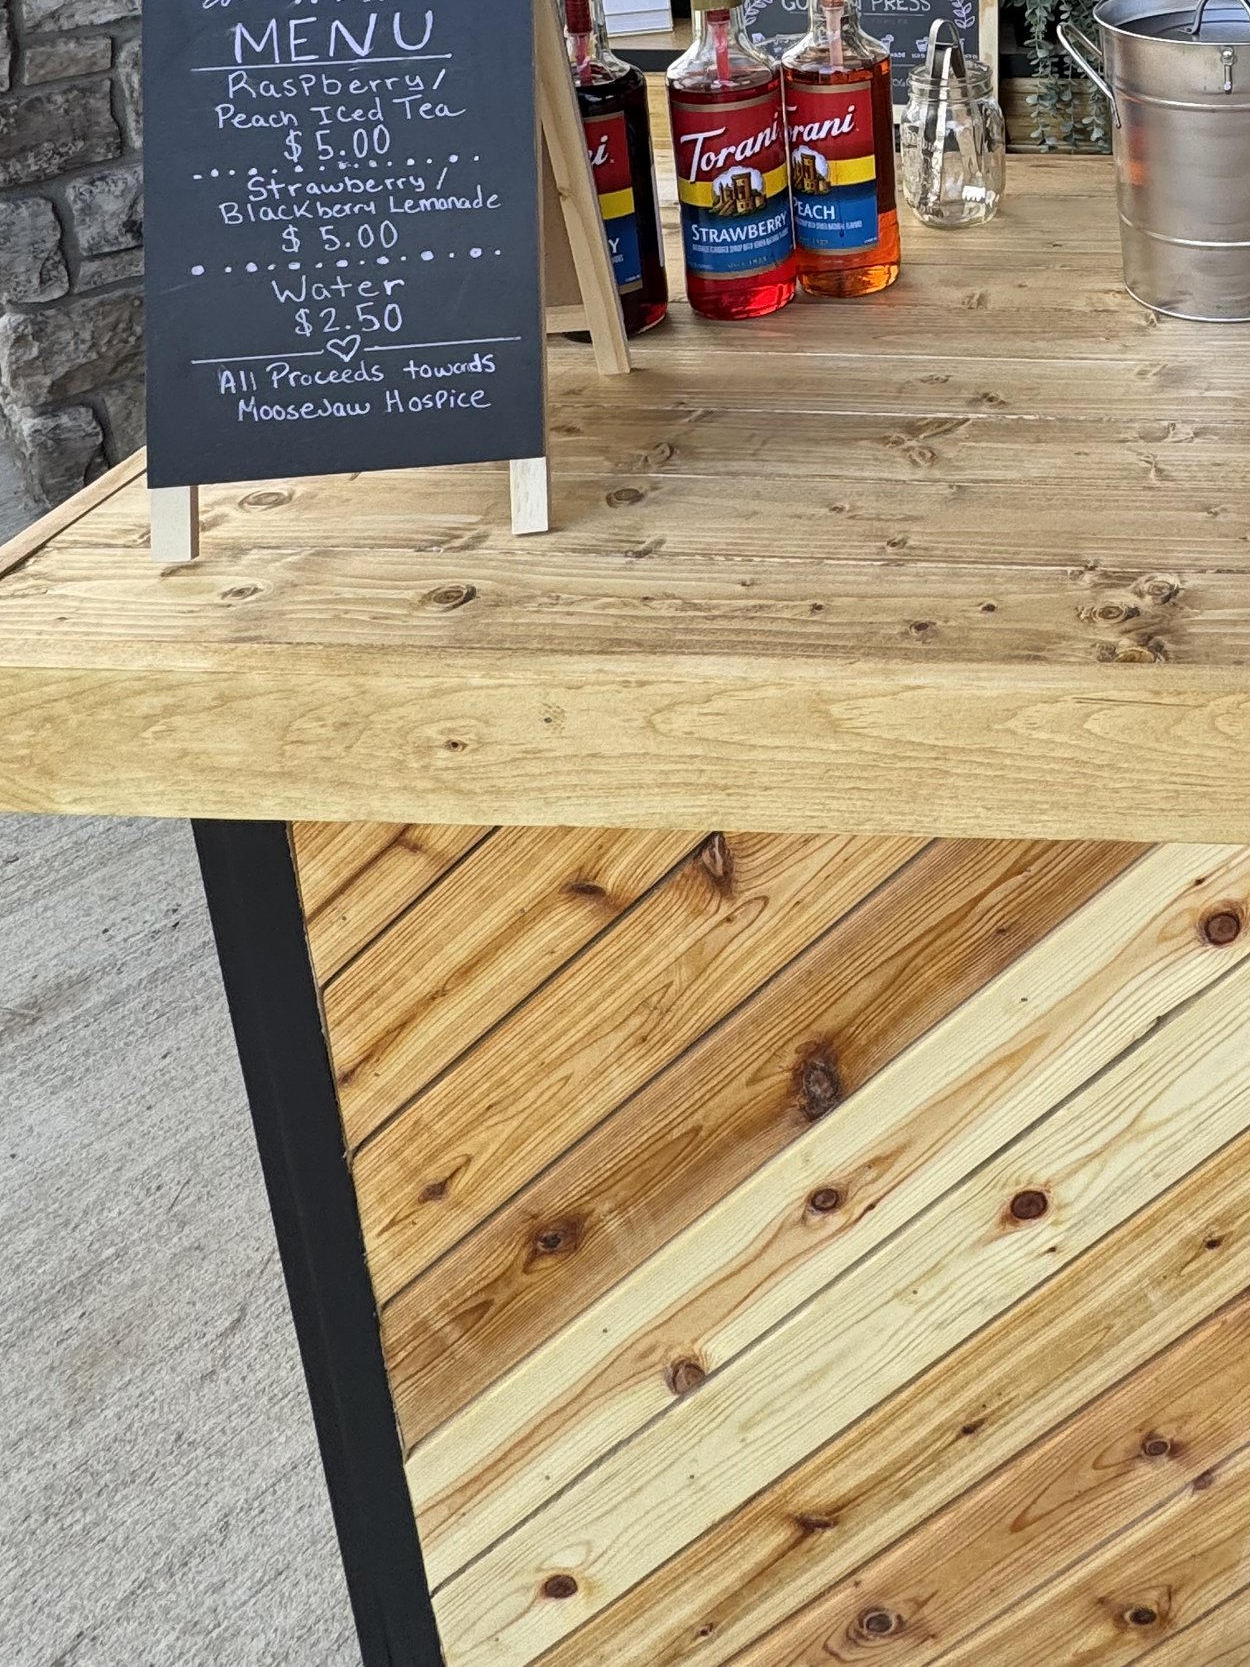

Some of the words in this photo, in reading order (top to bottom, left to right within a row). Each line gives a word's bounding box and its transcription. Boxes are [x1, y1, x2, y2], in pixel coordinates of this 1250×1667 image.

[234, 10, 434, 63] MENU
[215, 103, 298, 128] Peach
[310, 97, 384, 125] Iced
[392, 95, 466, 120] Tea
[680, 111, 779, 184] Torani
[219, 200, 376, 224] Blackberry
[389, 185, 501, 214] Lemonade
[692, 211, 788, 243] STRAWBERRY
[271, 275, 405, 303] Water
[295, 302, 403, 336] $2.50
[219, 370, 258, 395] All
[266, 361, 385, 389] Proceeds
[403, 353, 496, 379] towards
[385, 388, 492, 413] Hospice
